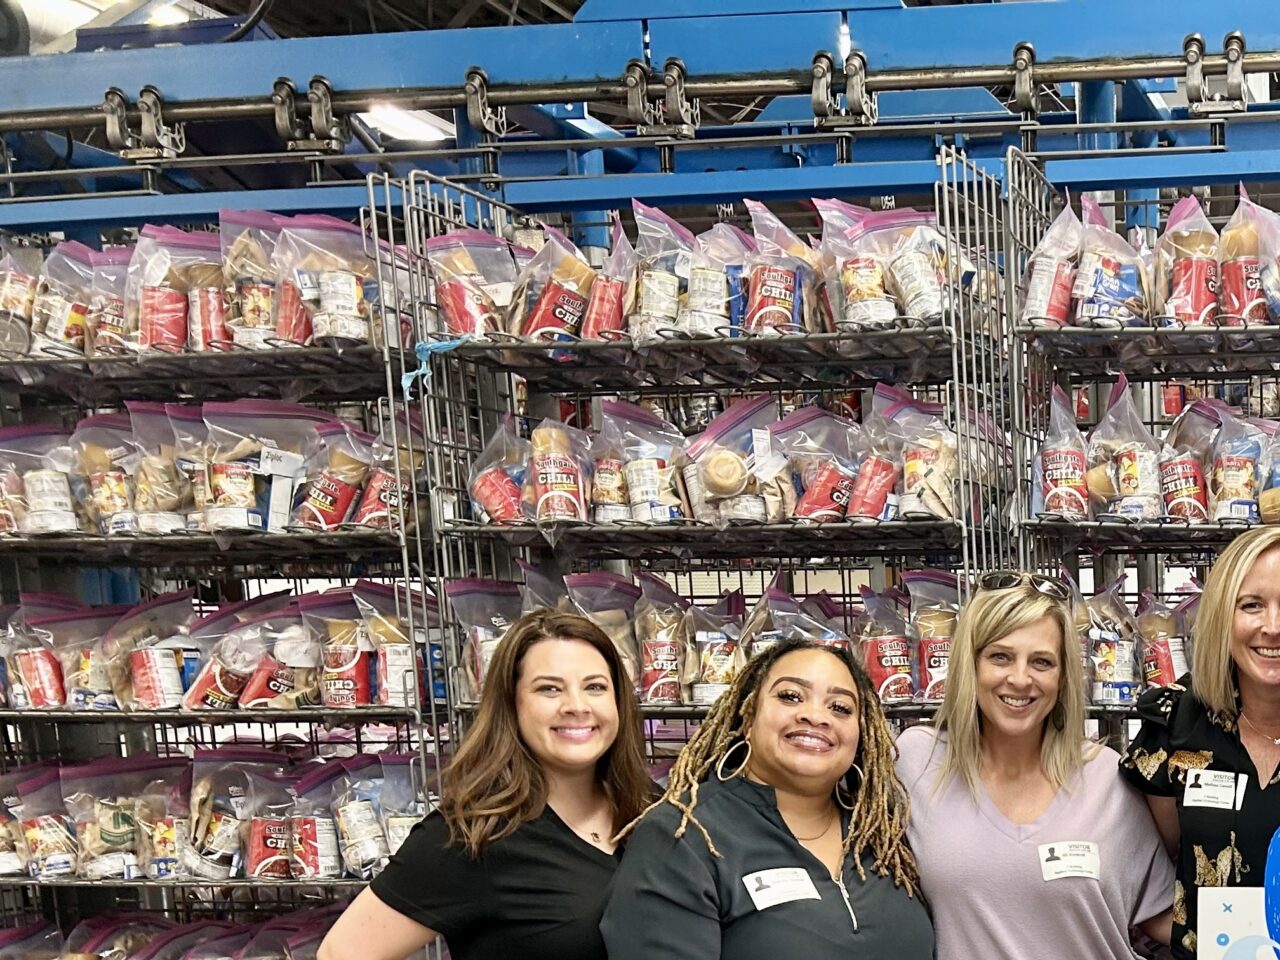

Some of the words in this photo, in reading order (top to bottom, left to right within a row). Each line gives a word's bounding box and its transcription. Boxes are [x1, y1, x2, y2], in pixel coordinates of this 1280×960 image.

[538, 473, 575, 485] CHILI
[1162, 476, 1195, 495] CHILI
[928, 642, 951, 653] South
